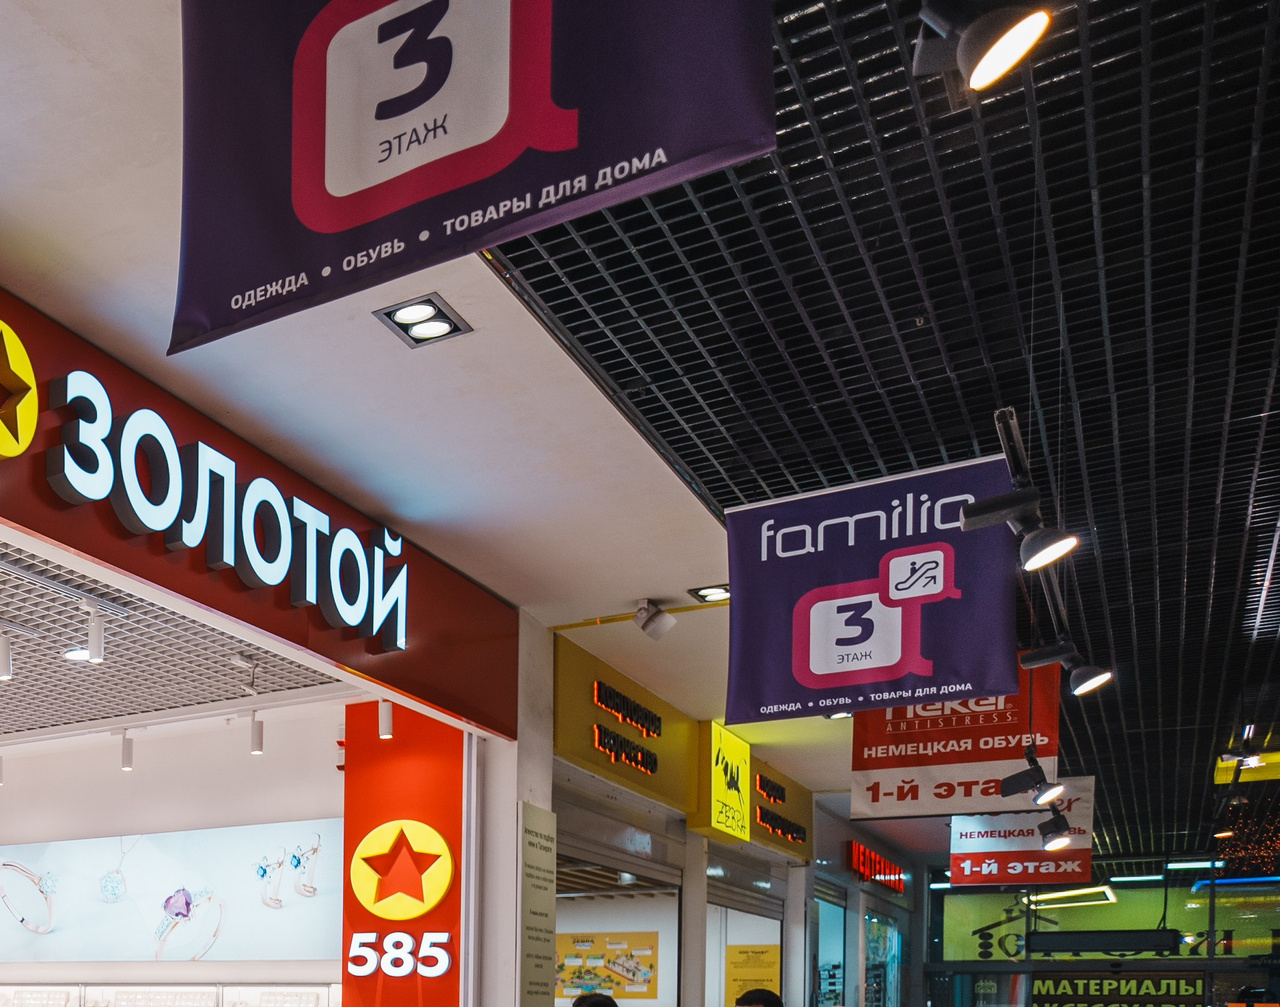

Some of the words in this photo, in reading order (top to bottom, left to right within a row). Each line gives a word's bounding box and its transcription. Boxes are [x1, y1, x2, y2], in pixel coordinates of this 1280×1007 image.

[374, 0, 454, 122] 3
[377, 113, 449, 164] ЭТАЖ
[230, 271, 309, 311] ОДЕЖДА
[341, 237, 406, 273] ОБУВЬ
[442, 193, 533, 237] ТОВАРЫ
[538, 175, 589, 209] ДЛЯ
[595, 147, 668, 191] ДОМА
[62, 369, 409, 652] ЗОЛОТОЙ
[834, 600, 874, 647] 3
[836, 650, 873, 664] ЭТАЖ
[760, 701, 802, 714] ОДЕЖДА
[819, 695, 852, 707] ОБУВЬ
[869, 689, 912, 701] ТОВАРЫ
[914, 685, 937, 697] ДЛЯ
[940, 682, 973, 695] ДОМА
[886, 712, 1012, 732] ANTISTRESS
[863, 738, 973, 759] НЕМЕЦКАЯ
[979, 733, 1049, 750] ОБУВЬ
[866, 778, 919, 803] 1-й
[933, 778, 1037, 799] эта
[959, 828, 1035, 840] НЕМЕЦКАЯ
[960, 859, 999, 875] 1-й
[1007, 860, 1082, 875] этаж
[347, 932, 452, 978] 585
[1033, 979, 1203, 996] МАТЕРИАЛЫ
